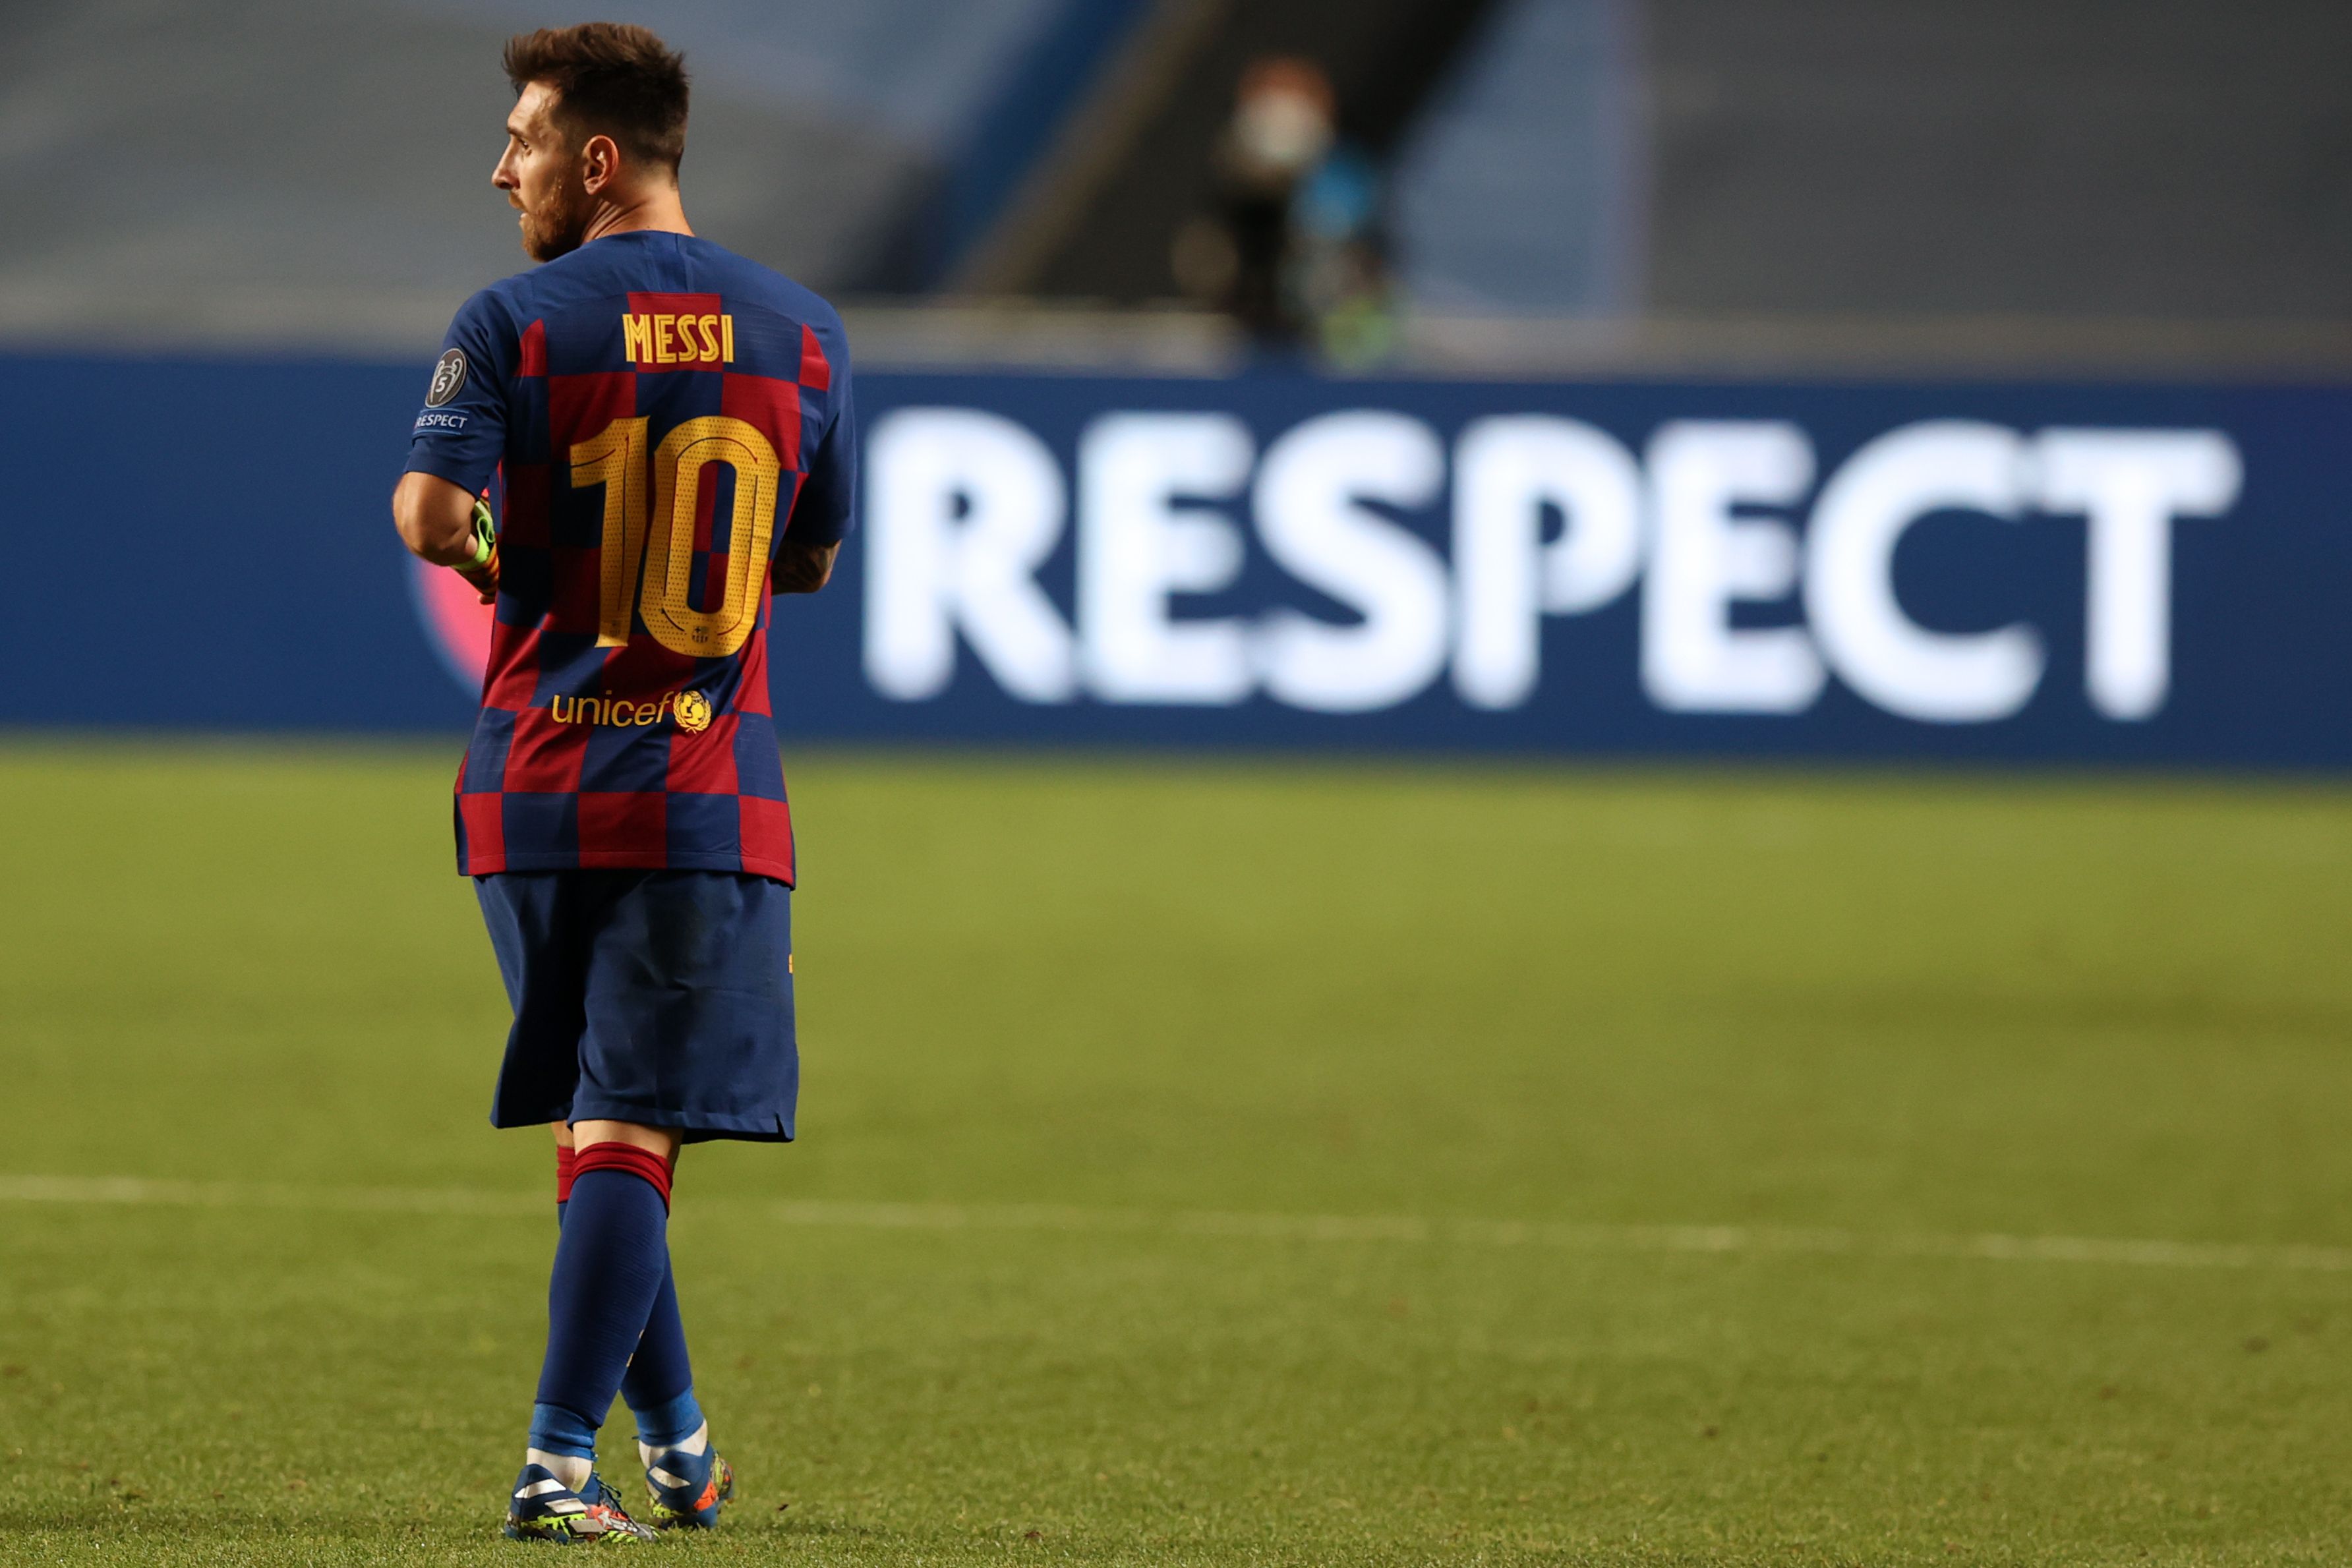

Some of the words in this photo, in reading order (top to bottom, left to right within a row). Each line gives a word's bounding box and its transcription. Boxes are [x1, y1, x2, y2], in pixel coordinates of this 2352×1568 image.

[622, 313, 734, 364] MESSI
[435, 377, 448, 392] 5
[416, 415, 467, 428] RESPECT
[570, 415, 780, 657] 10
[862, 405, 2245, 724] RESPECT
[552, 689, 674, 728] unicef
